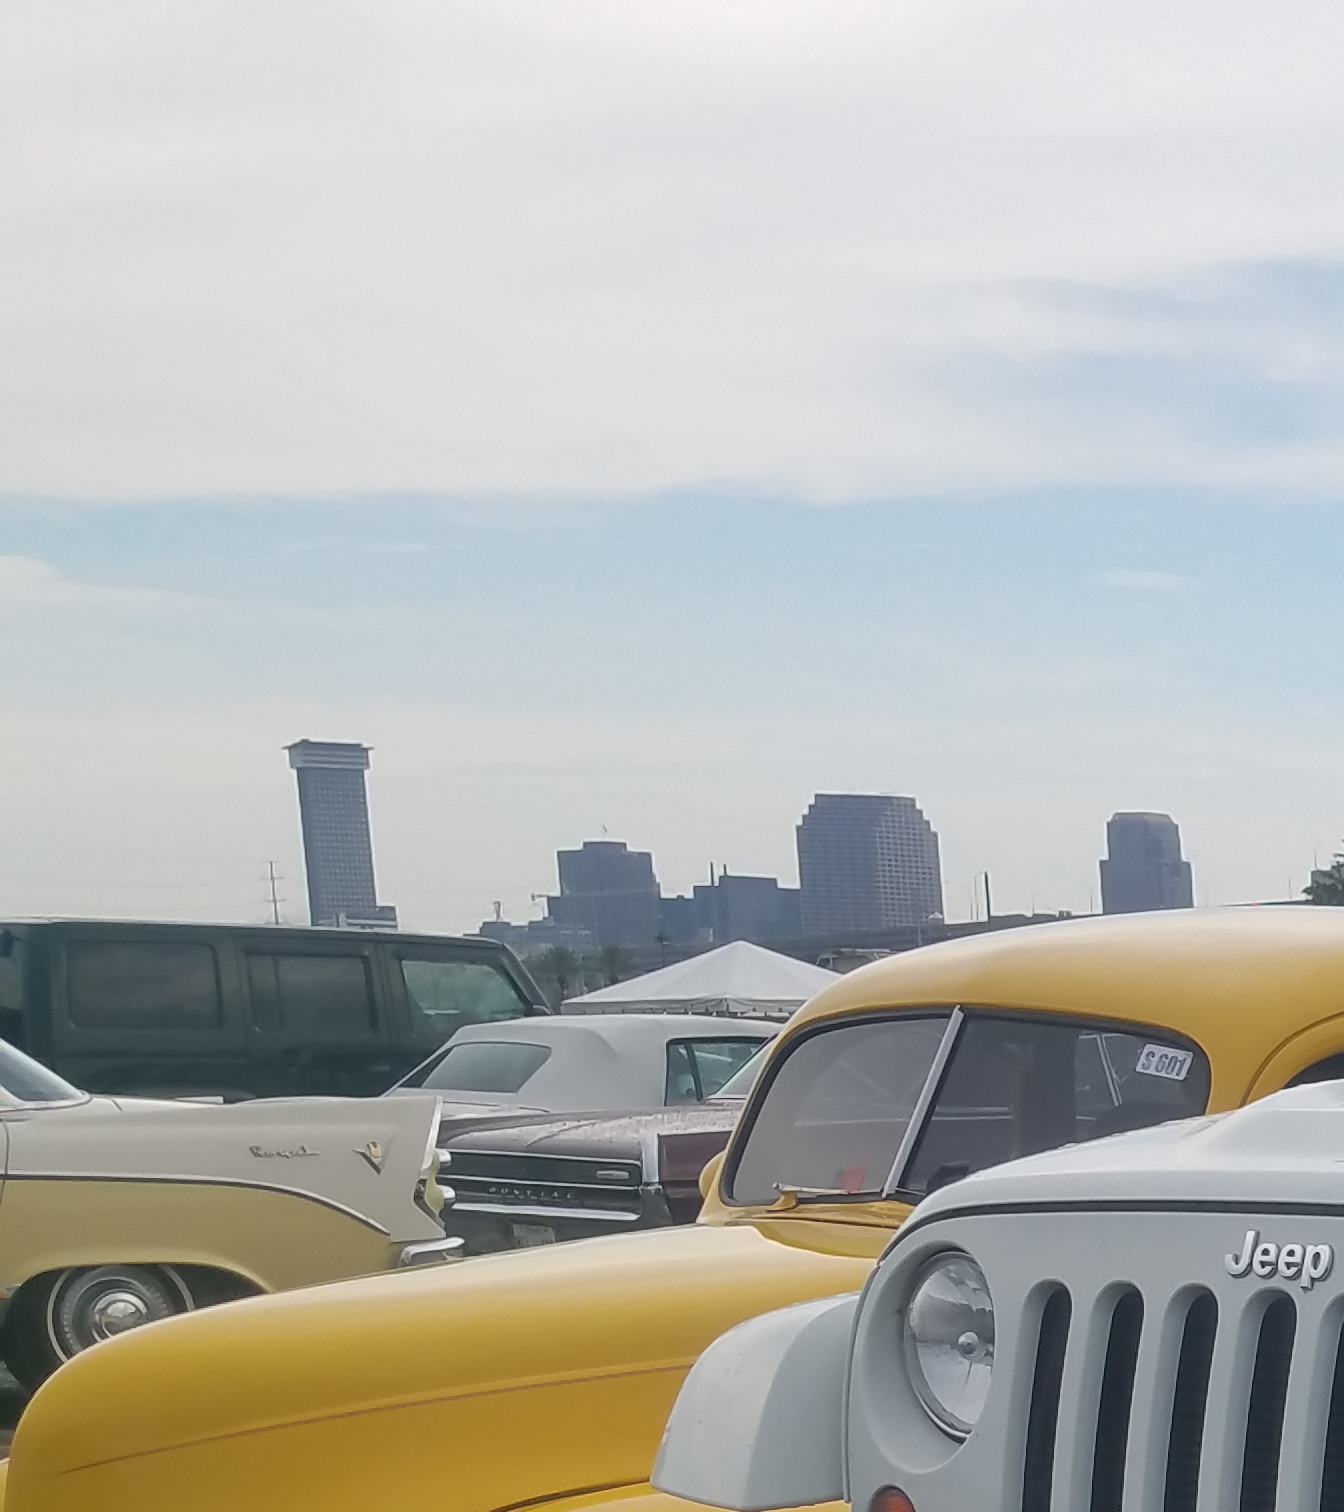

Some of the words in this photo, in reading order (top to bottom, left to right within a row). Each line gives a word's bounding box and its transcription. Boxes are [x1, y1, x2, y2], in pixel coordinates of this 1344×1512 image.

[1141, 1050, 1156, 1071] S
[1155, 1053, 1188, 1077] 601
[1224, 1230, 1334, 1292] Jeep
